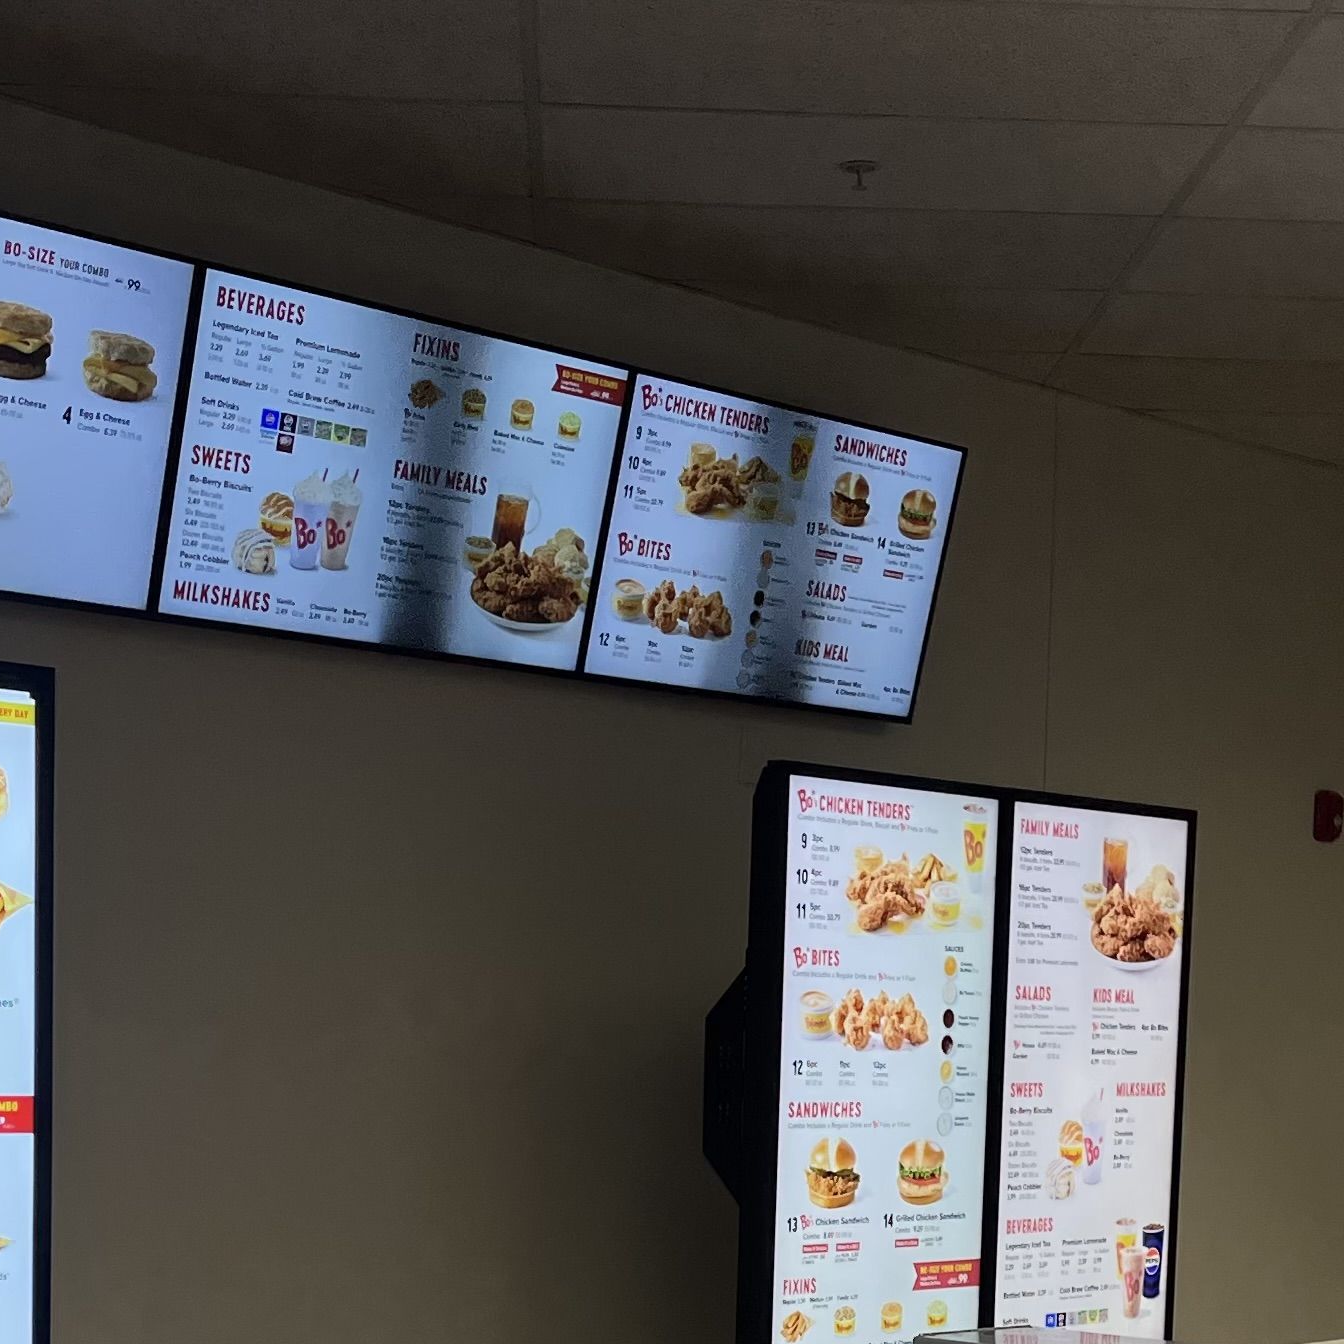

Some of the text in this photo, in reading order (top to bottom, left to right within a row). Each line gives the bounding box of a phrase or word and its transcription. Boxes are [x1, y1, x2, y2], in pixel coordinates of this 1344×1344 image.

[4, 240, 56, 265] BO-SIZE
[60, 258, 79, 270] YOUR
[216, 285, 305, 326] BEVERAGES
[213, 320, 249, 335] Legendary
[413, 333, 460, 362] FIXINS
[19, 396, 47, 409] Cheese
[62, 406, 72, 424] 4
[665, 394, 770, 434] CHICKEN TENDERS
[636, 426, 642, 439] 9
[834, 435, 907, 467] SANDWICHES
[191, 445, 251, 474] SWEETS
[628, 456, 639, 470] 10
[394, 460, 487, 495] FAMILY MEALS
[624, 485, 633, 499] 11
[638, 539, 671, 560] BITES
[173, 580, 270, 613] MILKSHAKES
[806, 580, 847, 602] SALADS
[599, 632, 609, 647] 12
[795, 640, 848, 662] KIDS MEAL
[15, 709, 28, 718] DAY
[819, 795, 910, 820] CHICKEN TENDERS
[1021, 819, 1078, 839] FAMILY MEALS
[801, 833, 807, 848] 9
[797, 869, 808, 884] 10
[797, 903, 806, 918] 11
[811, 950, 840, 966] BITES
[1015, 985, 1051, 1001] SALADS
[1093, 988, 1134, 1004] KIDS MEAL
[793, 1060, 803, 1075] 12
[1010, 1083, 1043, 1098] SWEETS
[1116, 1083, 1166, 1096] MILKSHAKES
[788, 1102, 861, 1118] SANDWICHES
[788, 1217, 797, 1232] 13
[841, 1216, 869, 1224] Sandwich
[884, 1214, 893, 1228] 14
[1006, 1218, 1053, 1234] BEVERAGES
[783, 1278, 816, 1295] FIXINS
